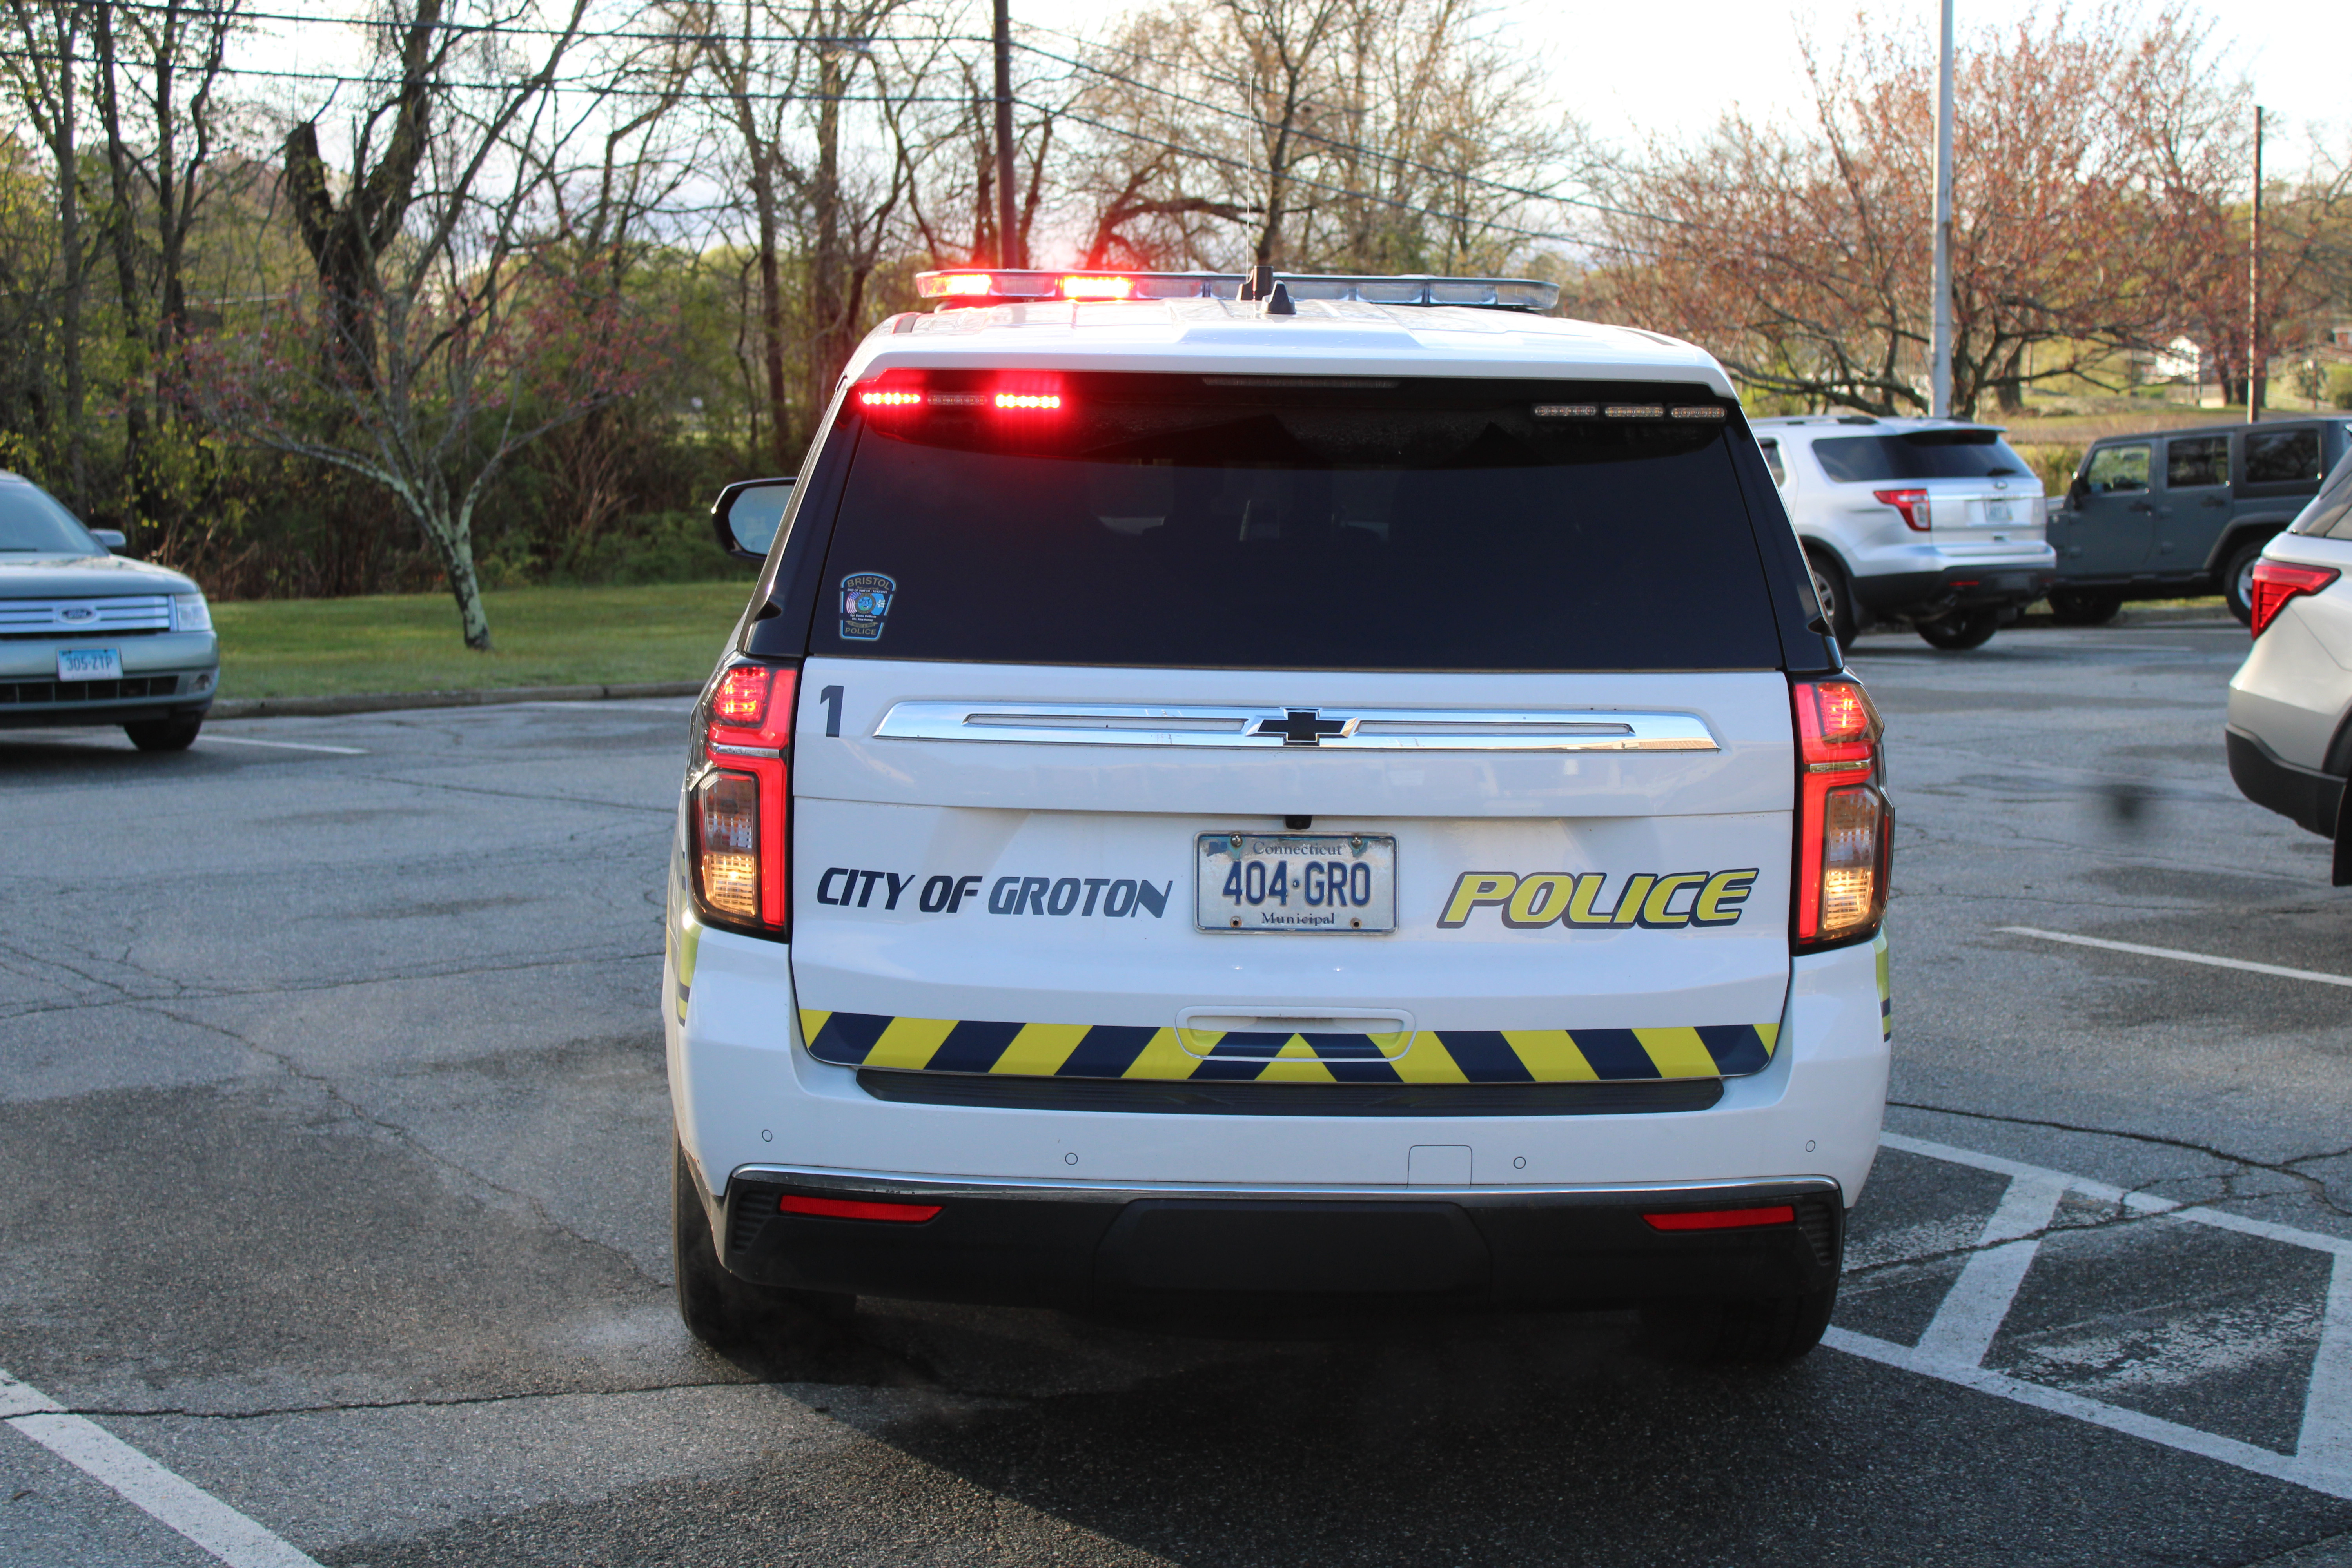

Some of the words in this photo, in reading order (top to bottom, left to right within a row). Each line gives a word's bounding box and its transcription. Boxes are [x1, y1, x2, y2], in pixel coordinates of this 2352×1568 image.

[847, 577, 889, 590] BRISTOL
[820, 685, 844, 738] 1
[1252, 841, 1342, 856] Connecticut
[817, 867, 916, 910] CITY
[919, 875, 983, 913] OF
[988, 876, 1173, 918] GROTON
[1436, 868, 1759, 929] POLICE
[1261, 912, 1335, 926] Municipal
